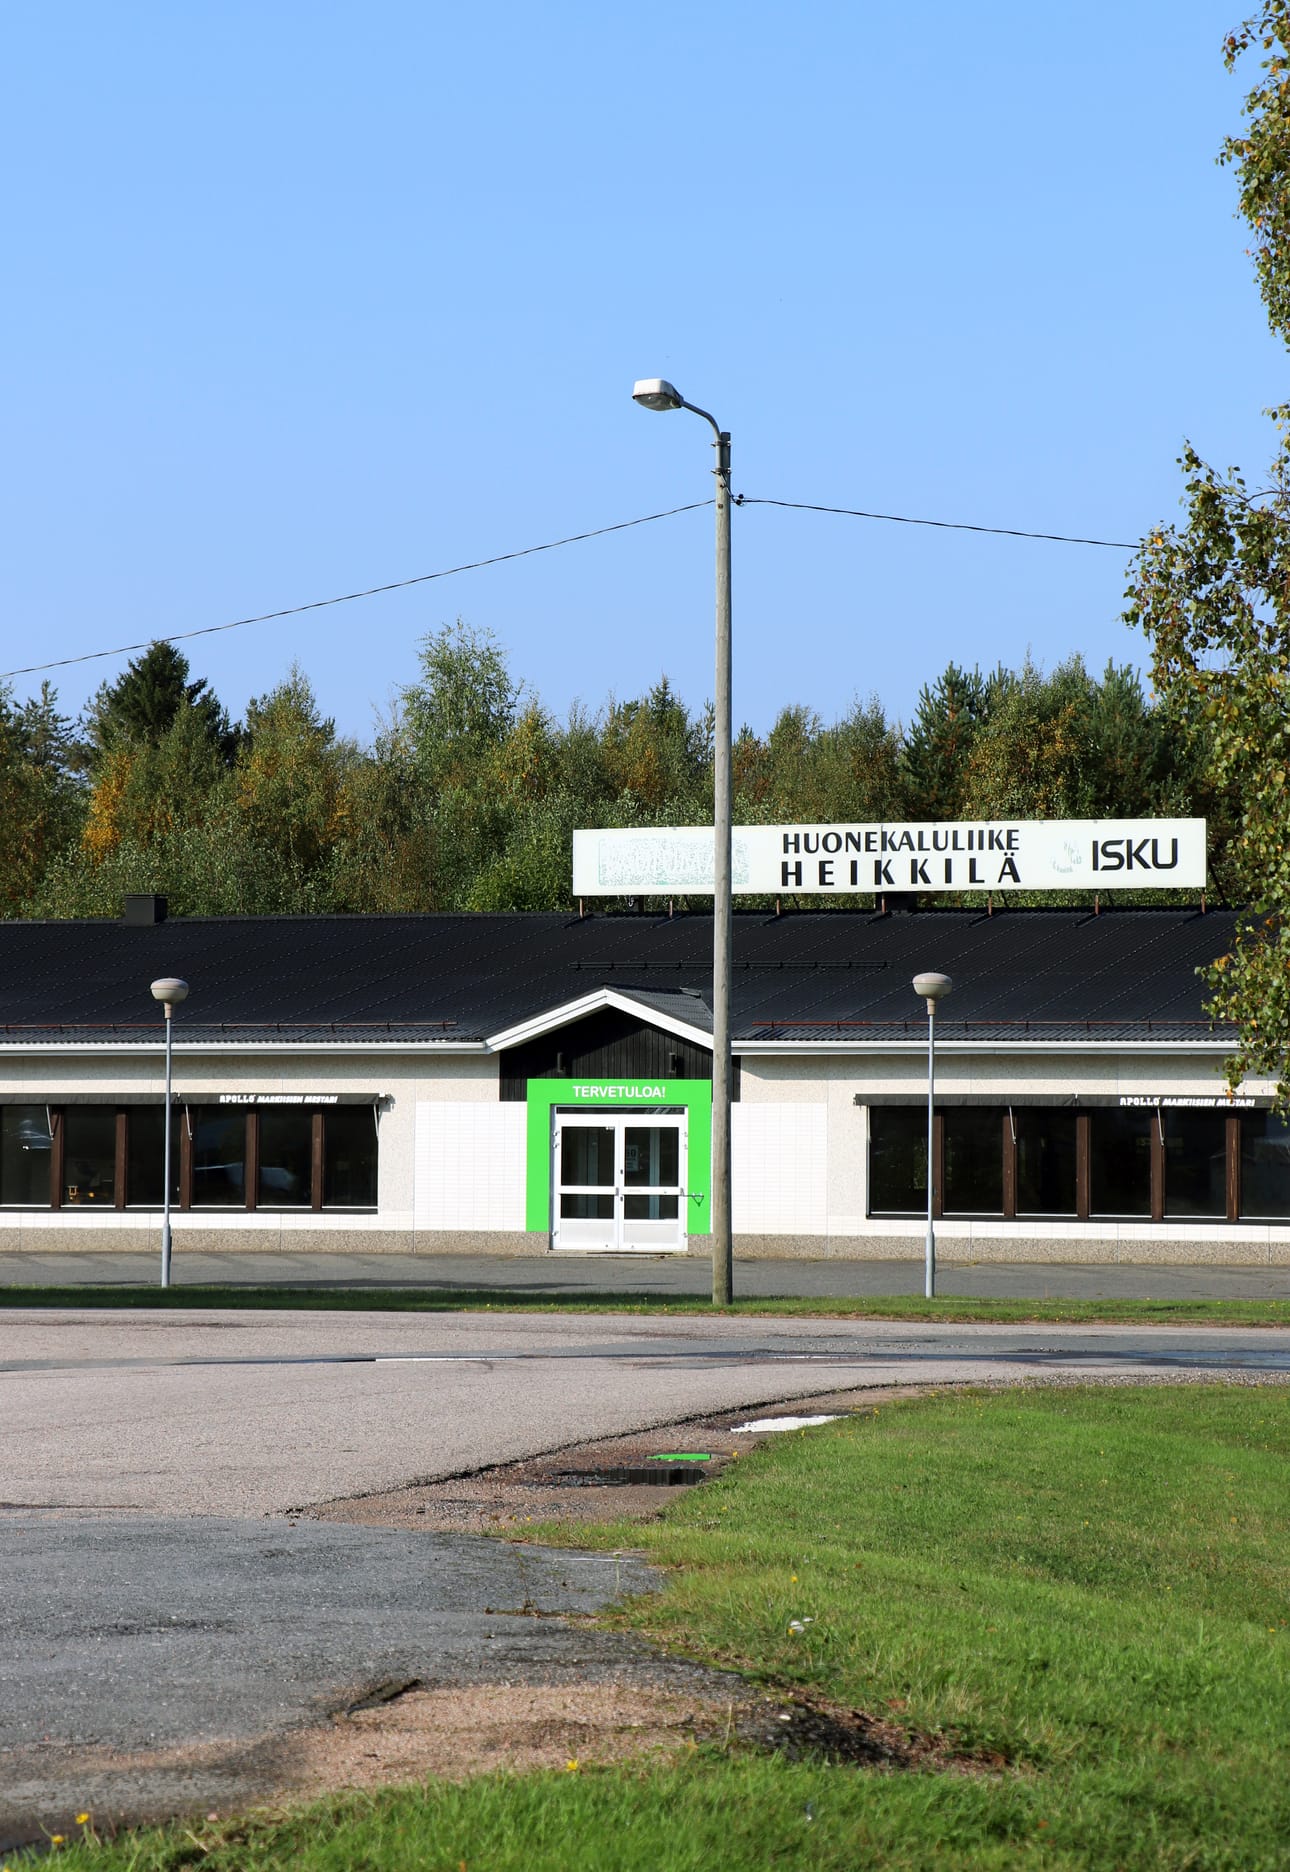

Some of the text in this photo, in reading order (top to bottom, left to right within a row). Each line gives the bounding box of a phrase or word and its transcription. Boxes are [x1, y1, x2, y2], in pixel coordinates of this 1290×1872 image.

[782, 829, 1021, 854] HUONEKALULIIKE
[1092, 838, 1179, 871] ISKU
[781, 853, 1022, 887] HEIKKILÄ
[219, 1095, 255, 1103] APOLLO
[572, 1085, 667, 1098] TERVETULOA!
[1119, 1097, 1160, 1106] APOLLO
